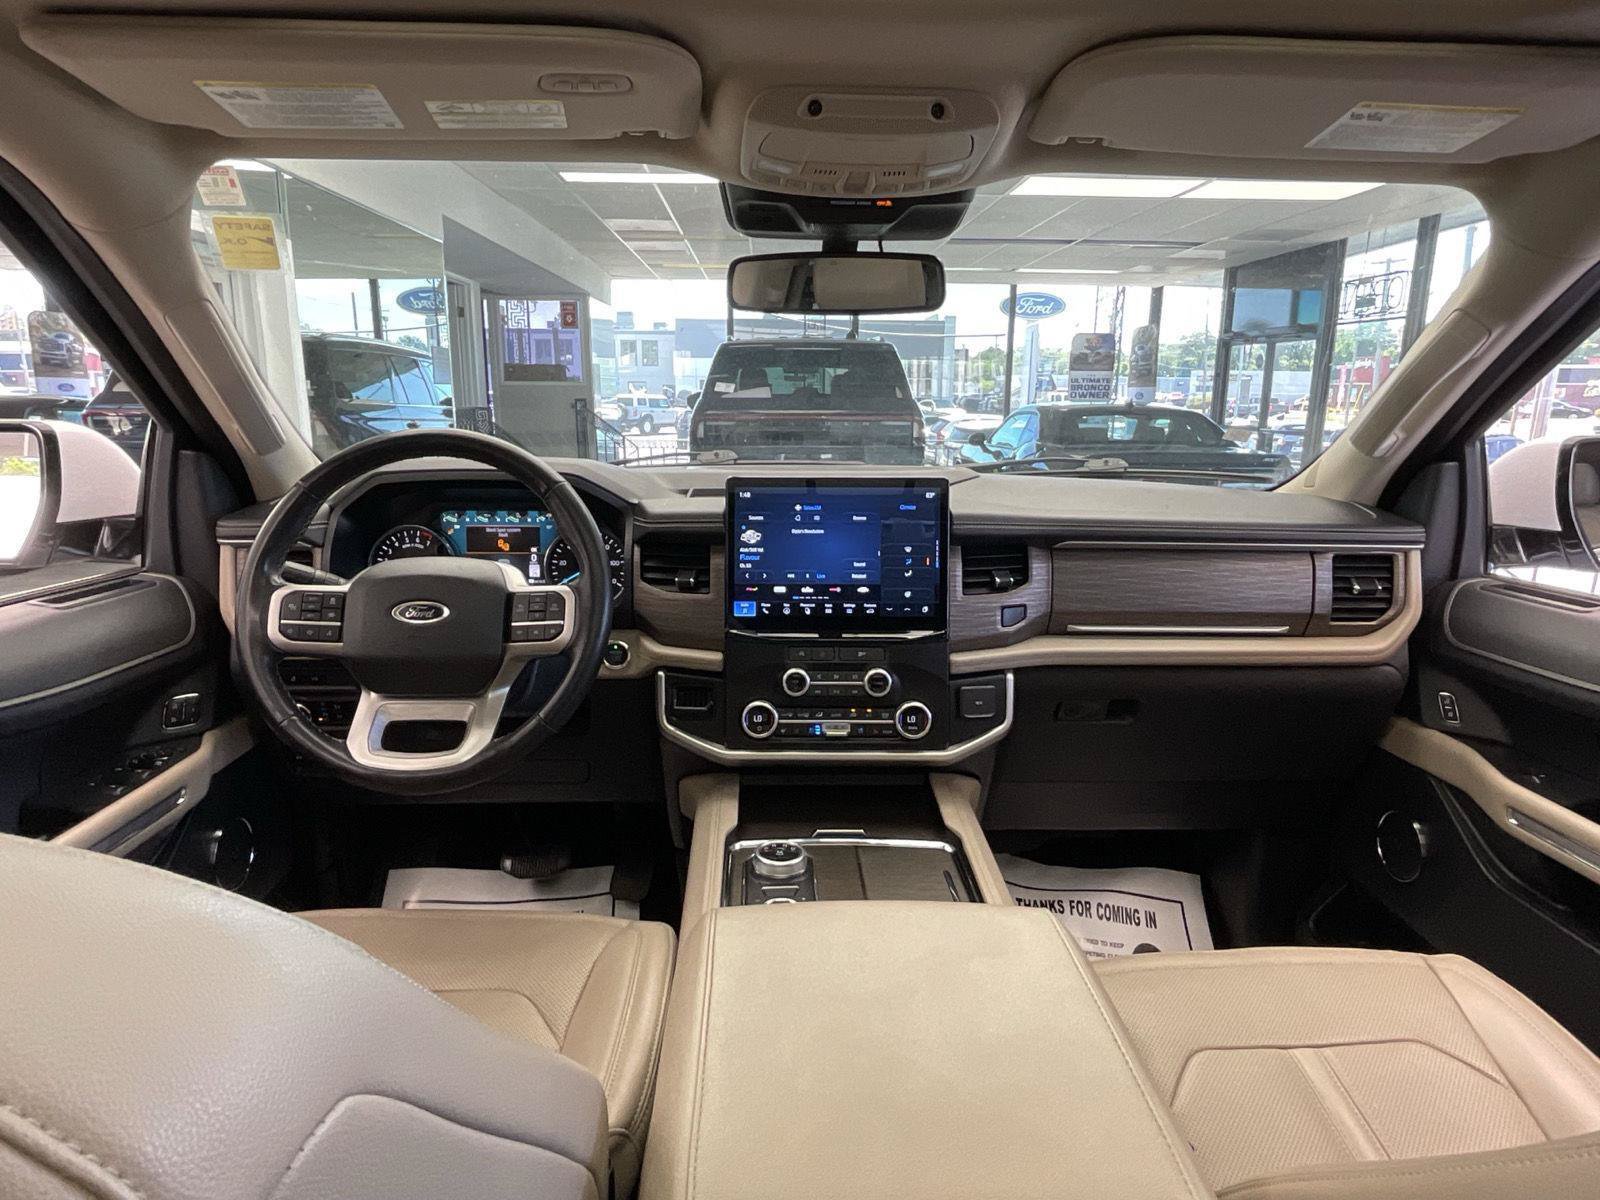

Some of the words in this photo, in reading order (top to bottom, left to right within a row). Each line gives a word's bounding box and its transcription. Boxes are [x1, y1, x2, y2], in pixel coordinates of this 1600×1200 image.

[1016, 296, 1054, 315] Ford
[1069, 391, 1111, 399] OWNER
[404, 605, 435, 619] Ford
[753, 714, 763, 723] LO
[906, 715, 916, 723] LO
[1015, 897, 1065, 915] THANKS
[1069, 901, 1092, 919] FOR
[1097, 902, 1141, 926] COMING
[1145, 910, 1158, 929] IN
